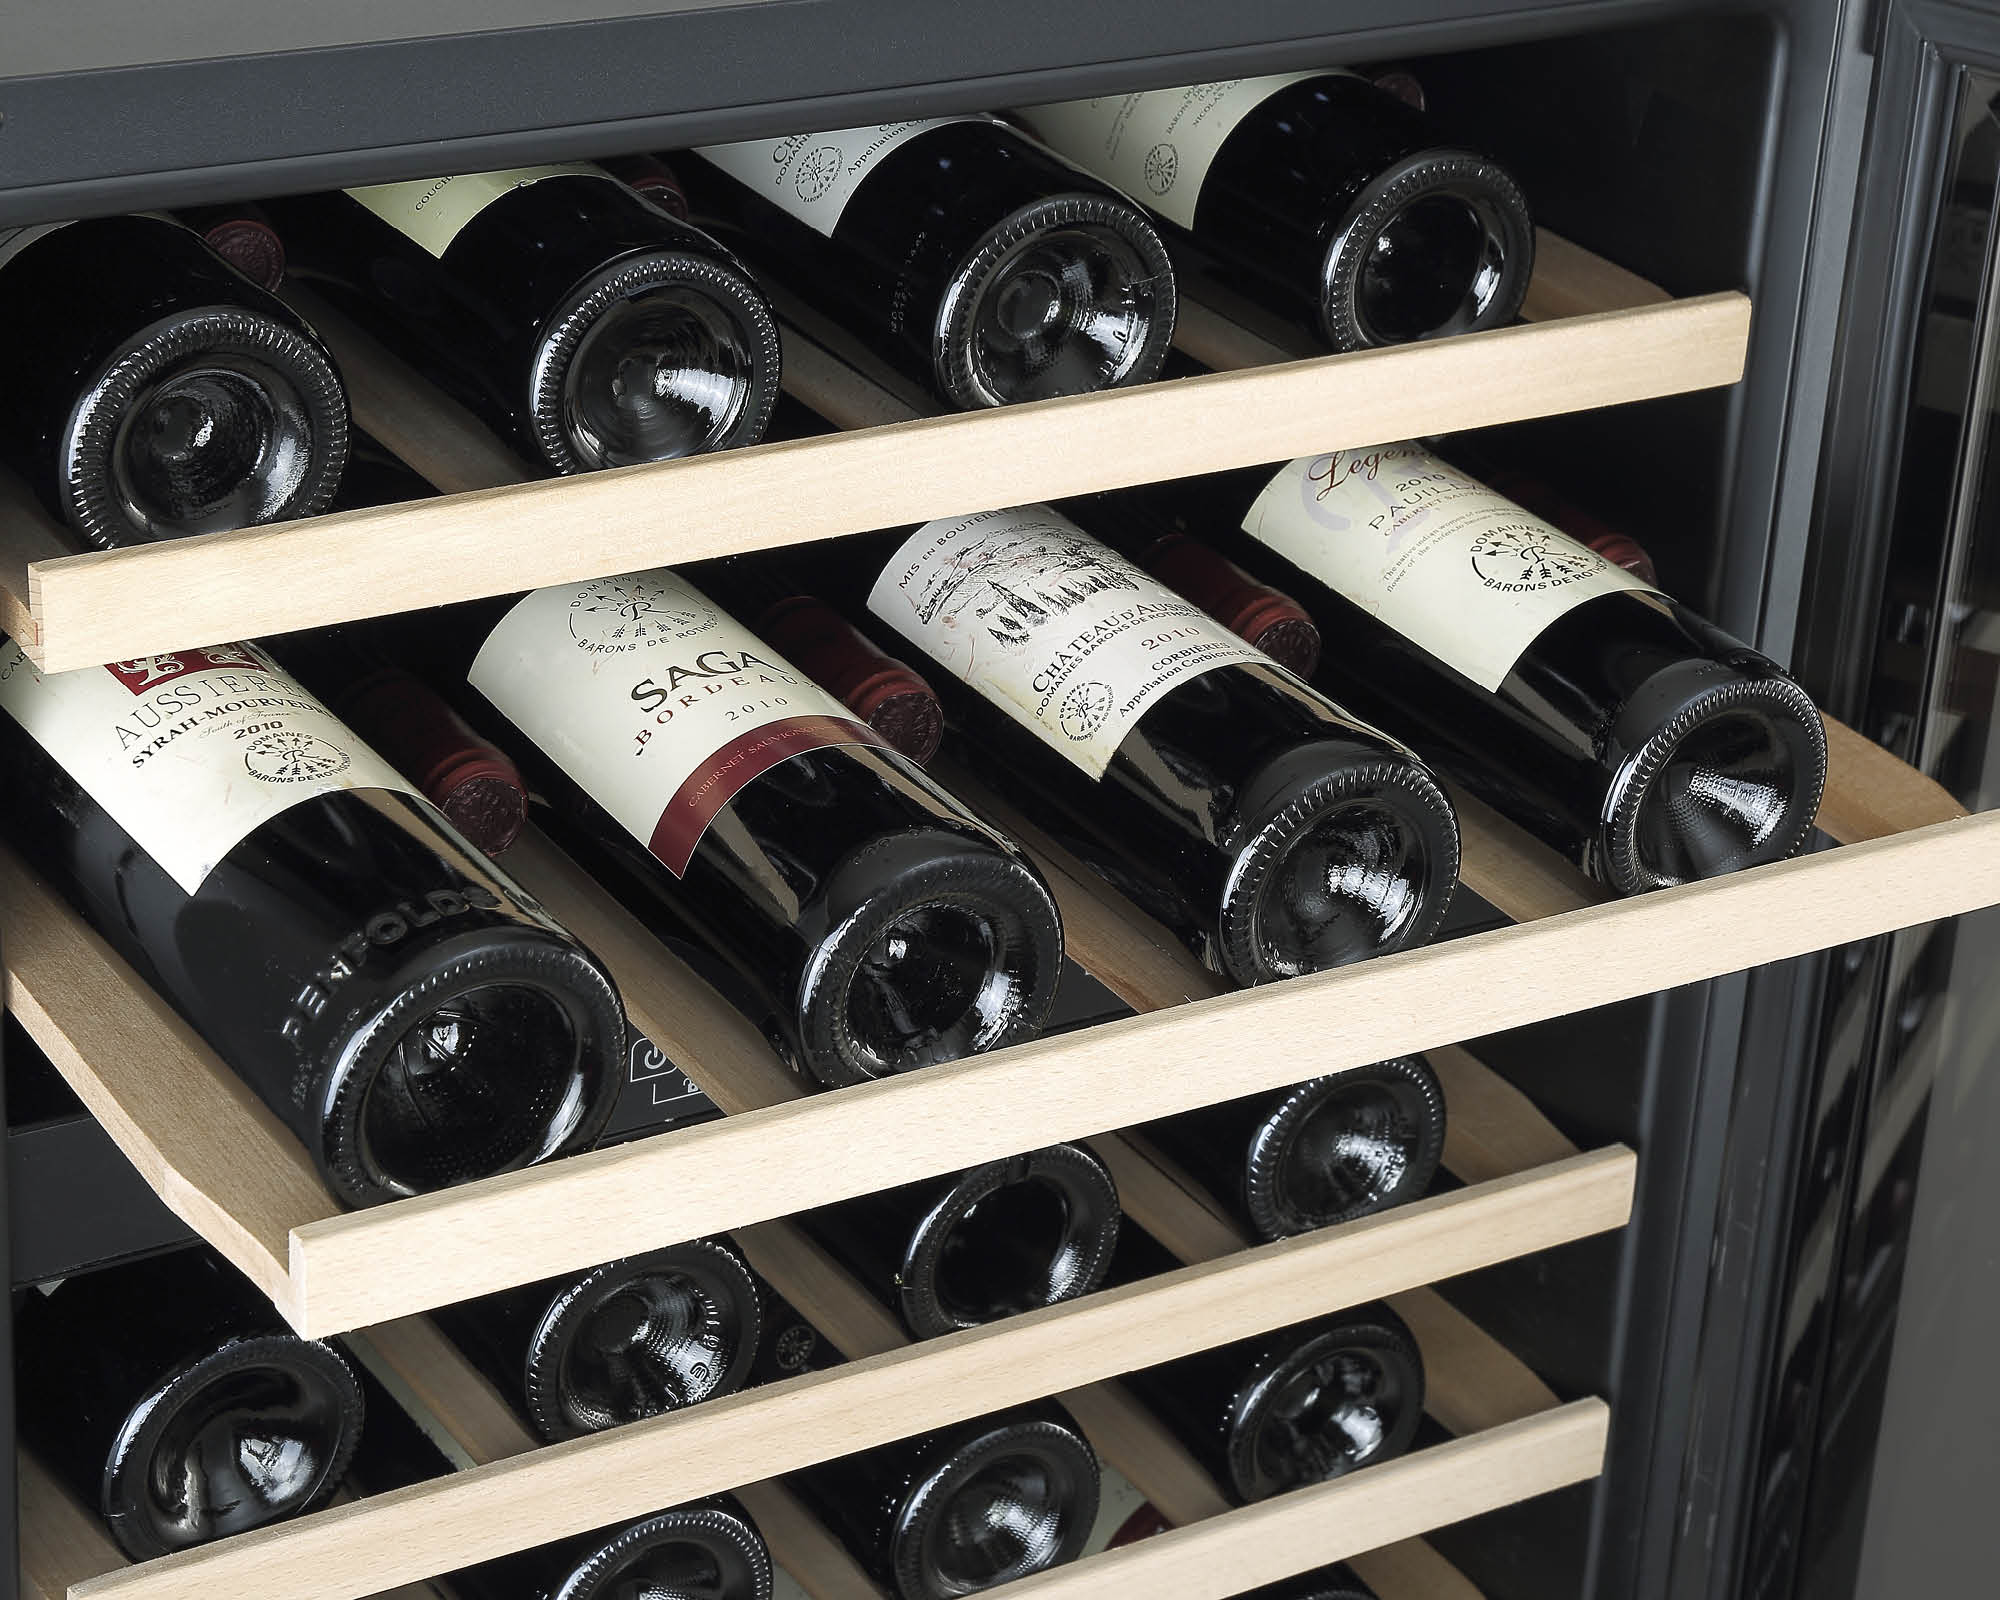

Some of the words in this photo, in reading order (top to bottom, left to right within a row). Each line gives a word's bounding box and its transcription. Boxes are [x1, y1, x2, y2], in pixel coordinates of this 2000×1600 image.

[847, 126, 906, 176] Appellation
[1395, 473, 1447, 492] 2010
[1384, 498, 1442, 537] CABERNET
[1470, 524, 1546, 553] DOMAINES
[898, 563, 920, 589] MIS
[922, 547, 936, 561] EN
[570, 576, 660, 608] DOMAINES
[1483, 577, 1548, 592] BARONS
[1551, 576, 1573, 587] DE
[577, 638, 637, 654] BARONS
[647, 636, 670, 647] DE
[1032, 614, 1120, 694] CHÂTEAU
[1141, 627, 1200, 651] 2010
[631, 650, 789, 713] SAGA
[1036, 657, 1084, 717] DOMAINES
[1083, 623, 1130, 656] BARONS
[1131, 617, 1148, 626] DE
[1119, 665, 1182, 718] Appellation
[724, 697, 789, 721] 2010
[233, 720, 284, 740] 2010
[246, 731, 313, 751] DOMAINES
[248, 769, 295, 783] BARONS
[688, 751, 745, 808] CABERNET
